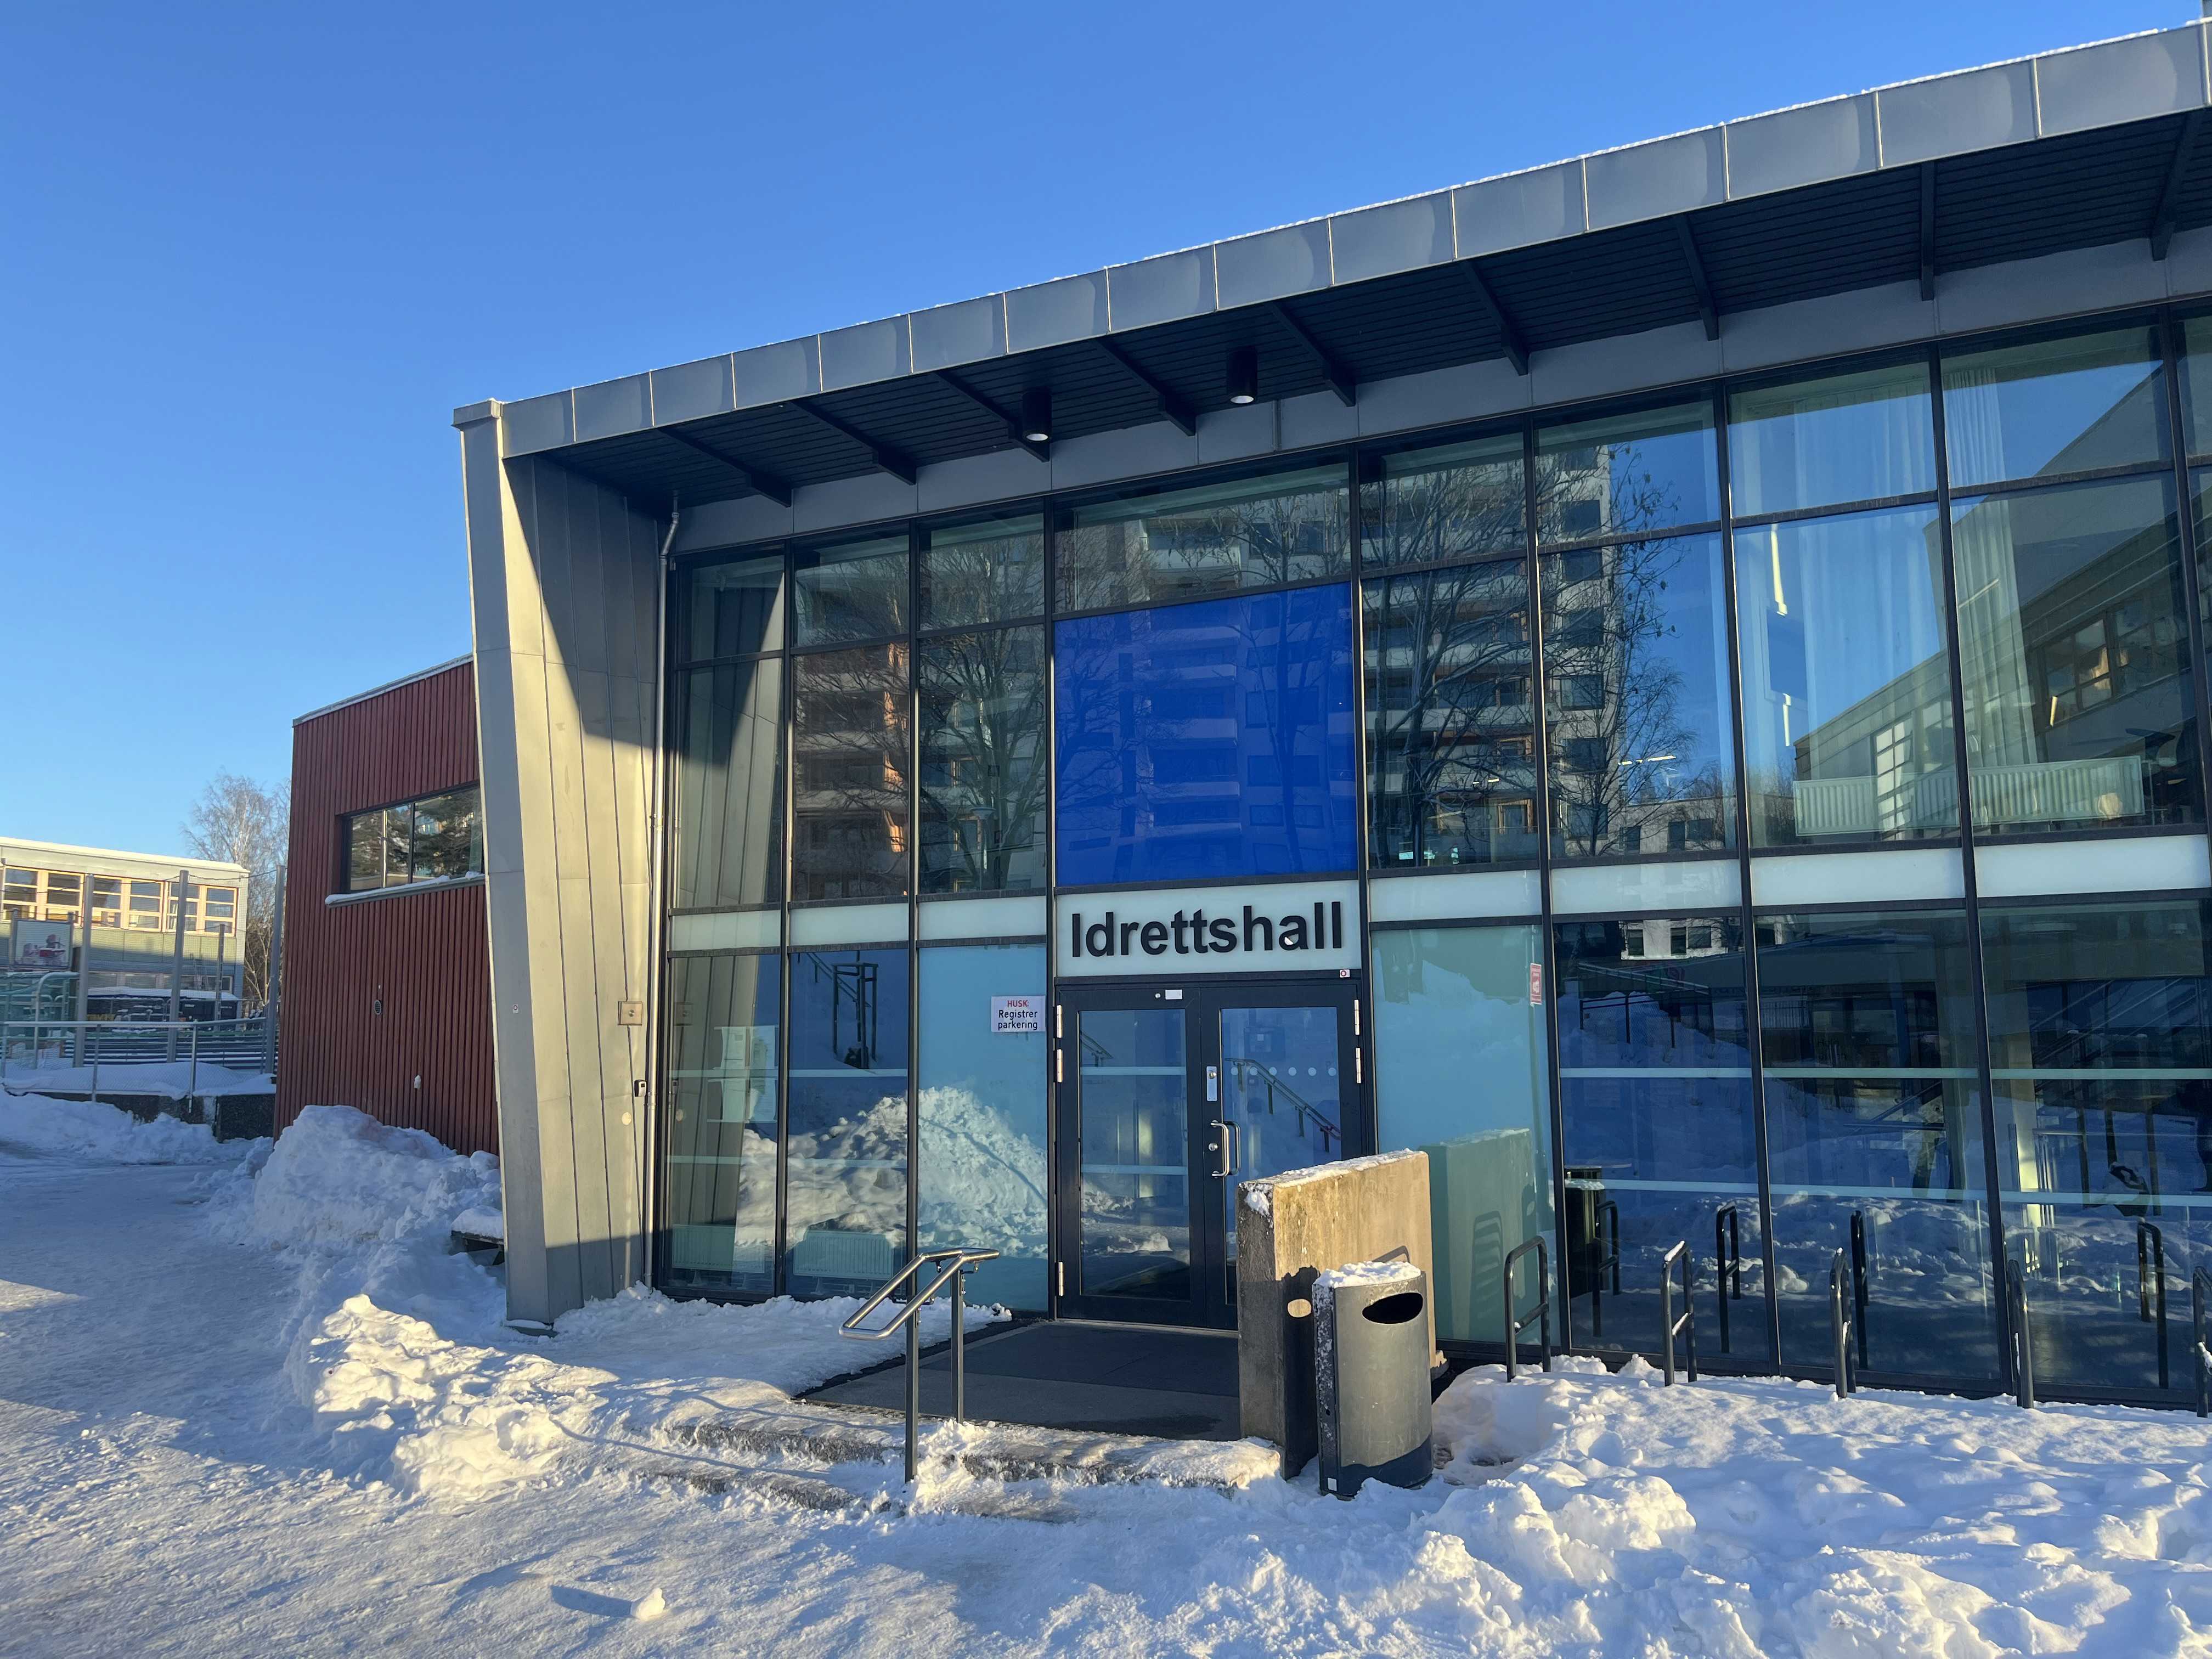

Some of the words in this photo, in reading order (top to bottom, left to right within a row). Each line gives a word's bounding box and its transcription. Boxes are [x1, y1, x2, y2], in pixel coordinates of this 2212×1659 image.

[1071, 901, 1342, 957] Idrettshall
[998, 1009, 1038, 1020] Registrer
[998, 1019, 1038, 1031] parkering
